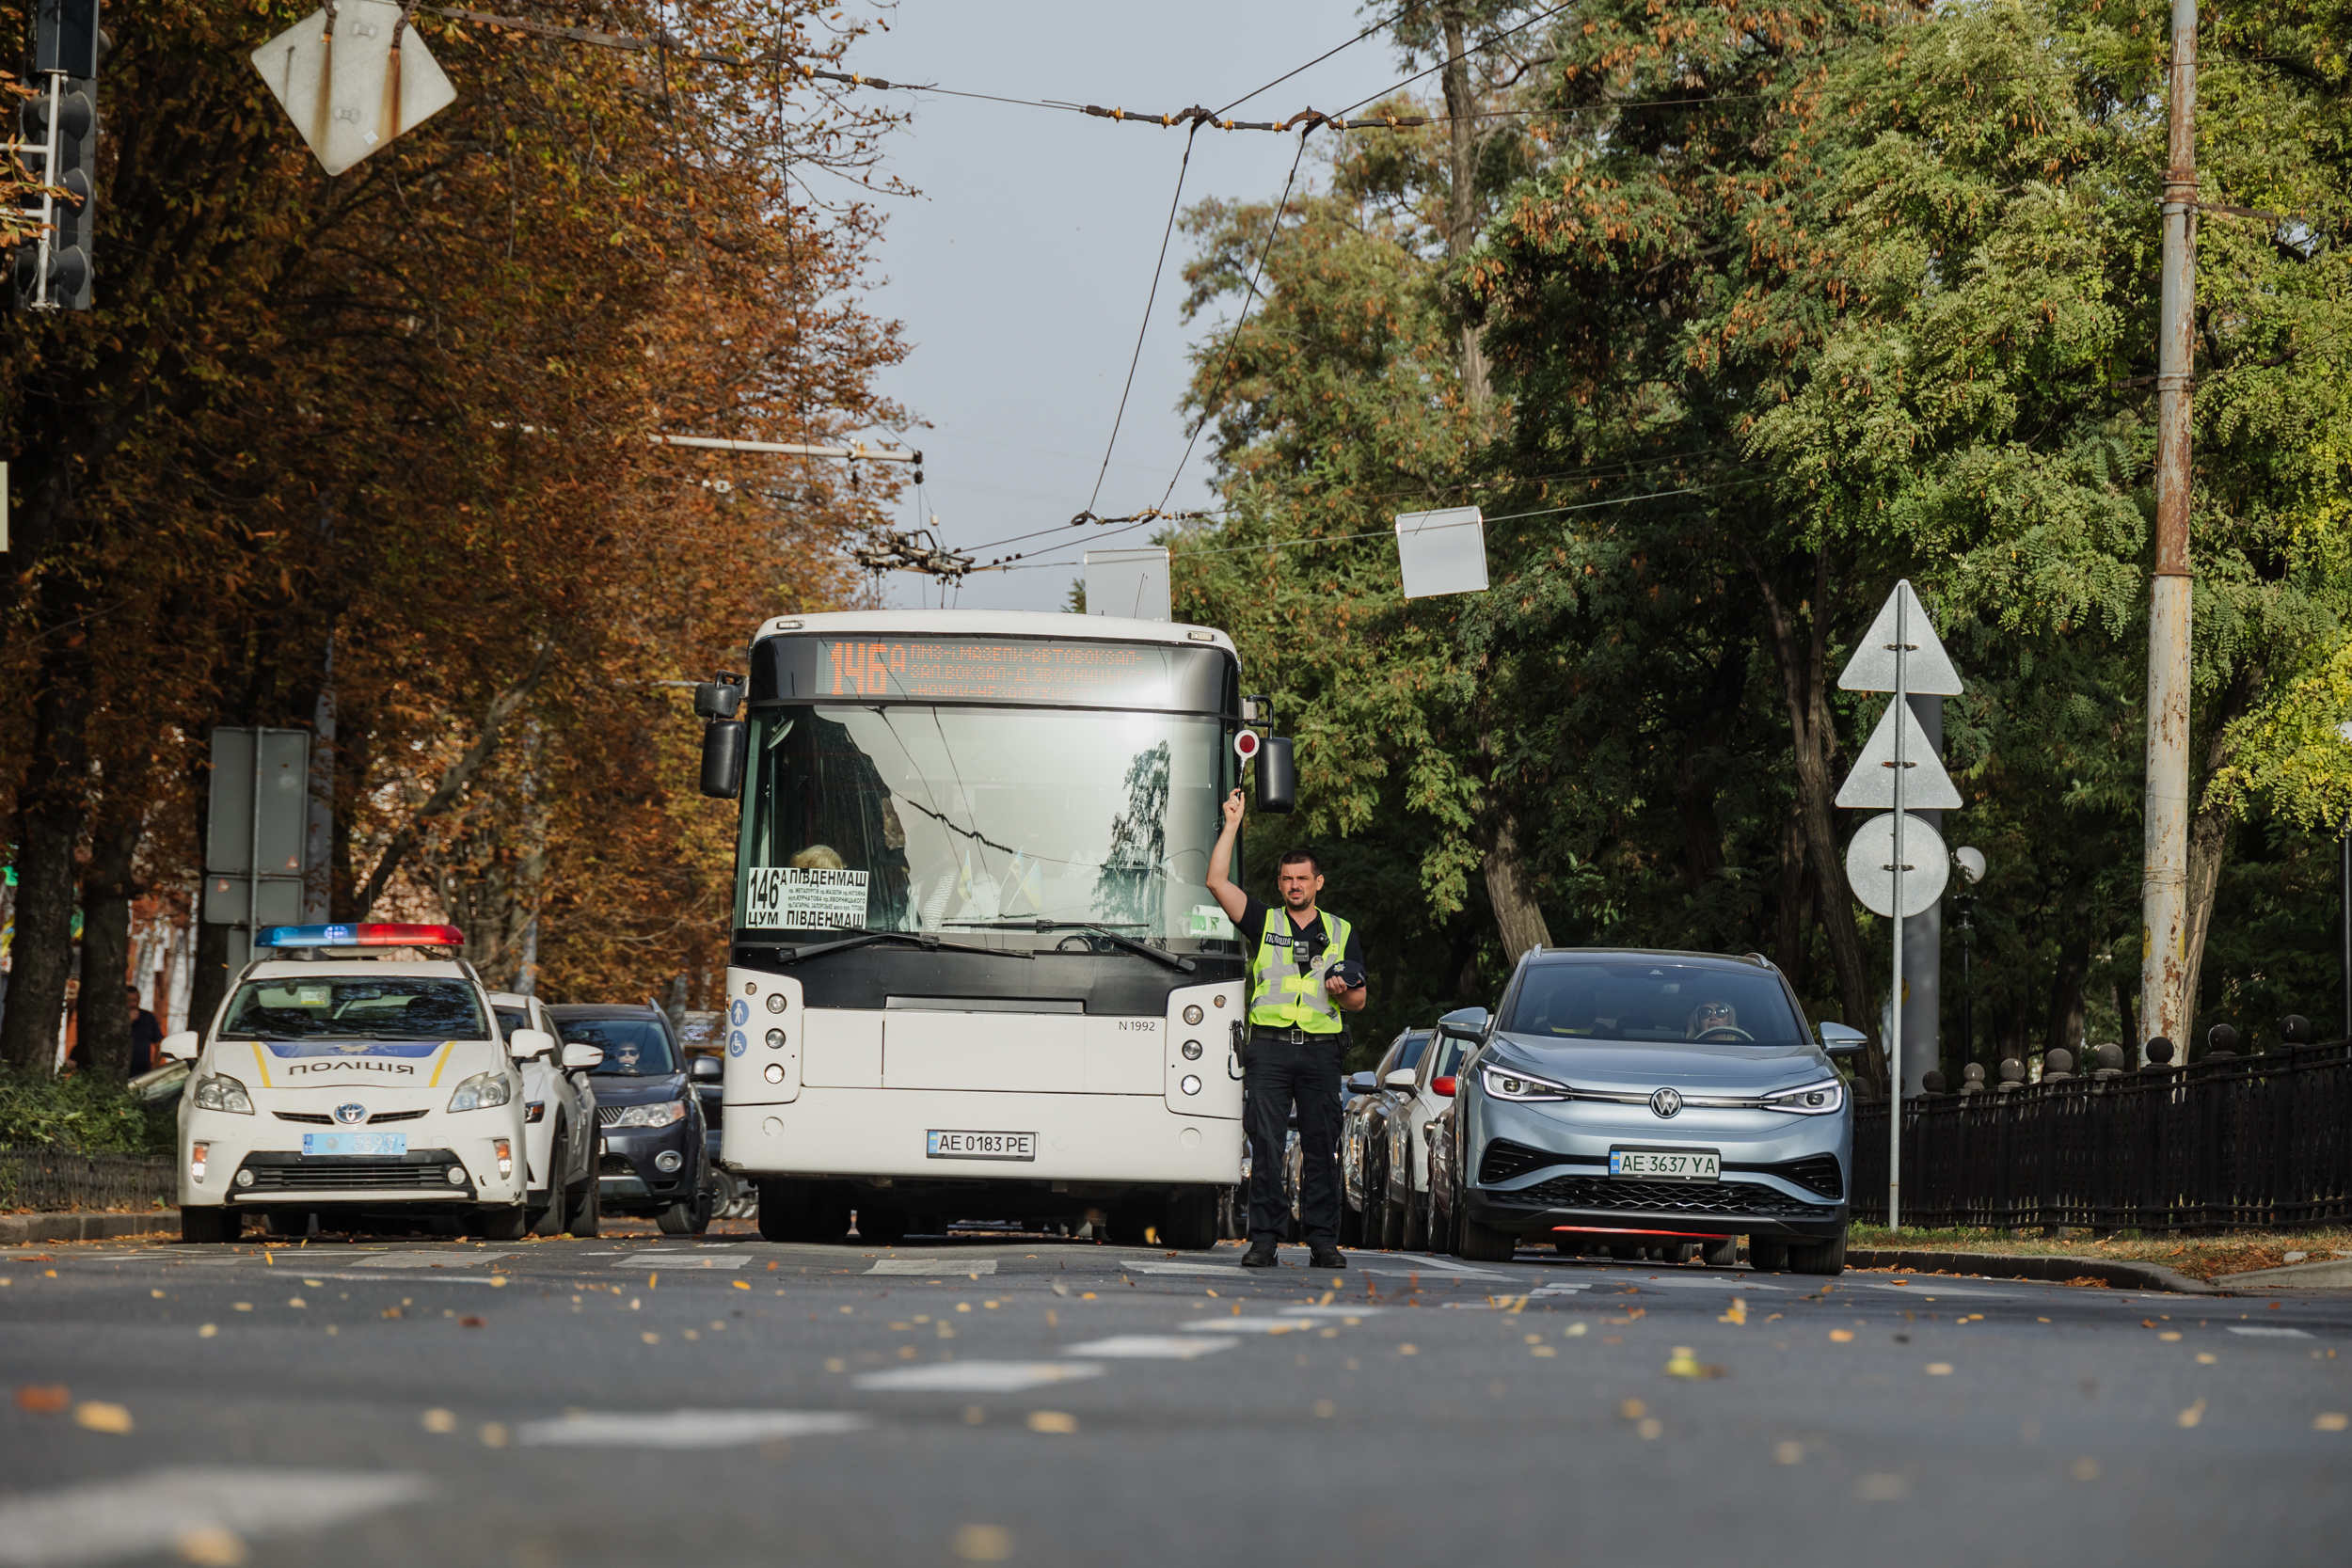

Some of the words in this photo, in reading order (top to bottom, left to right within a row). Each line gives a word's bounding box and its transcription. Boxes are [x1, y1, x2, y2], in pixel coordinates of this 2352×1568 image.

[789, 869, 866, 887] ПІВДЕНМАШ
[748, 911, 778, 927] ЦУМ
[787, 911, 865, 929] ПІВДЕНМАШ
[1119, 1022, 1127, 1031] N
[1131, 1022, 1155, 1032] 1992
[289, 1061, 414, 1075] ПОЛІЦІЯ
[939, 1135, 961, 1150] AE
[966, 1135, 1002, 1152] 0183
[1007, 1137, 1028, 1152] PE
[1621, 1155, 1645, 1171] AE
[1649, 1156, 1687, 1172] 3637
[1692, 1157, 1716, 1174] YA
